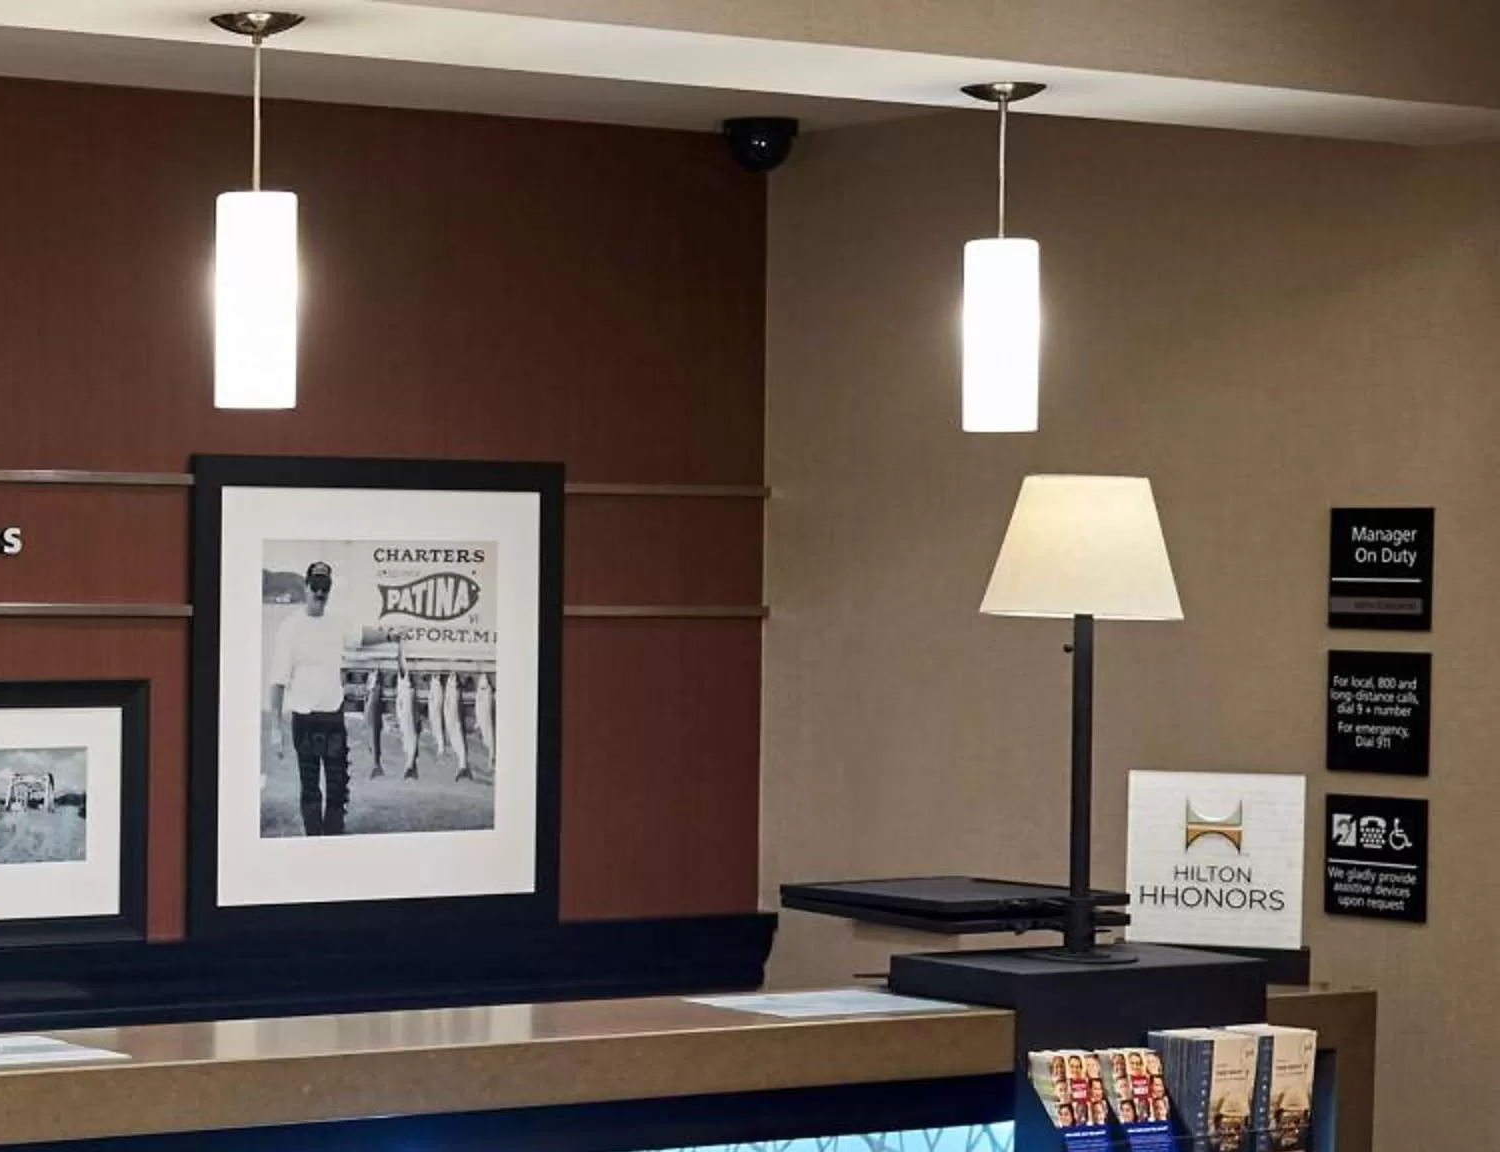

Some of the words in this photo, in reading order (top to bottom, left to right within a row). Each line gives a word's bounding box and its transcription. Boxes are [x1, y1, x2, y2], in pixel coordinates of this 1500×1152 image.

[1351, 525, 1418, 546] Manager
[373, 548, 485, 563] CHARTERS
[1355, 547, 1377, 563] On
[1381, 547, 1417, 568] Duty
[386, 575, 470, 618] PATINA
[1333, 675, 1349, 687] For
[1398, 676, 1418, 690] and
[1373, 705, 1412, 716] number
[1337, 721, 1353, 733] For
[1355, 736, 1375, 748] Dial
[1173, 865, 1253, 884] HILTON
[1139, 885, 1285, 911] HHONORS
[1337, 895, 1365, 909] upon
